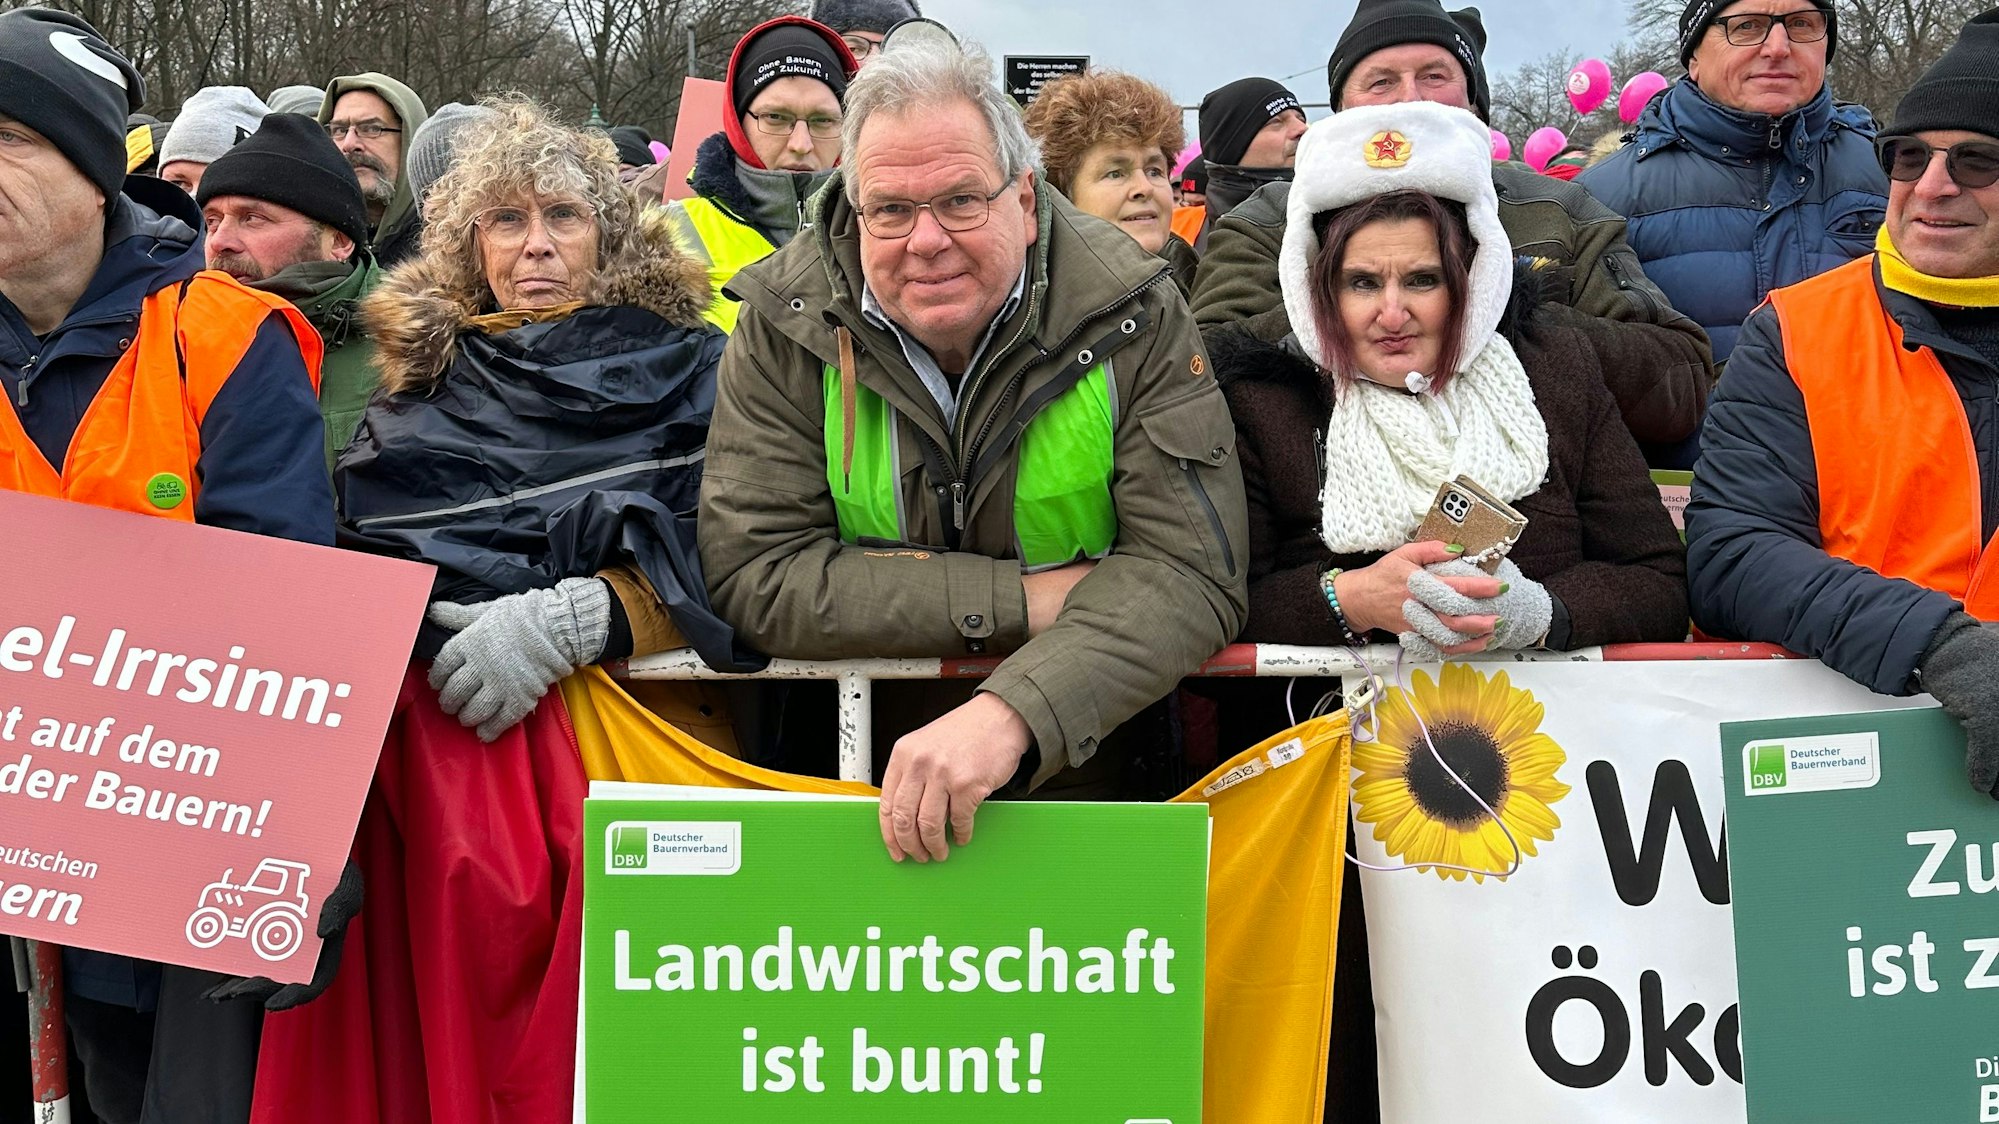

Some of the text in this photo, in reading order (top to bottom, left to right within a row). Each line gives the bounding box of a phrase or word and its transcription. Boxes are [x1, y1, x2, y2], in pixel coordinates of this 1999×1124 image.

[753, 70, 775, 86] keine
[779, 65, 822, 77] Zukunft
[758, 56, 822, 73] Ohne Bauern
[0, 615, 352, 728] el-Irrsinn:
[0, 705, 221, 777] t auf dem
[1790, 747, 1841, 759] Deutscher
[1791, 756, 1867, 770] Bauernverband
[1753, 772, 1783, 787] DBV
[0, 753, 273, 838] der Bauern!
[653, 833, 704, 842] Deutscher
[653, 844, 728, 853] Bauernverband
[614, 854, 645, 866] DBV
[1906, 829, 1999, 898] Zu
[0, 880, 84, 926] ern
[614, 925, 1176, 995] Landwirtschaft
[1846, 926, 1999, 998] ist z
[742, 1026, 1046, 1094] ist bunt!
[1975, 1056, 1999, 1078] Di
